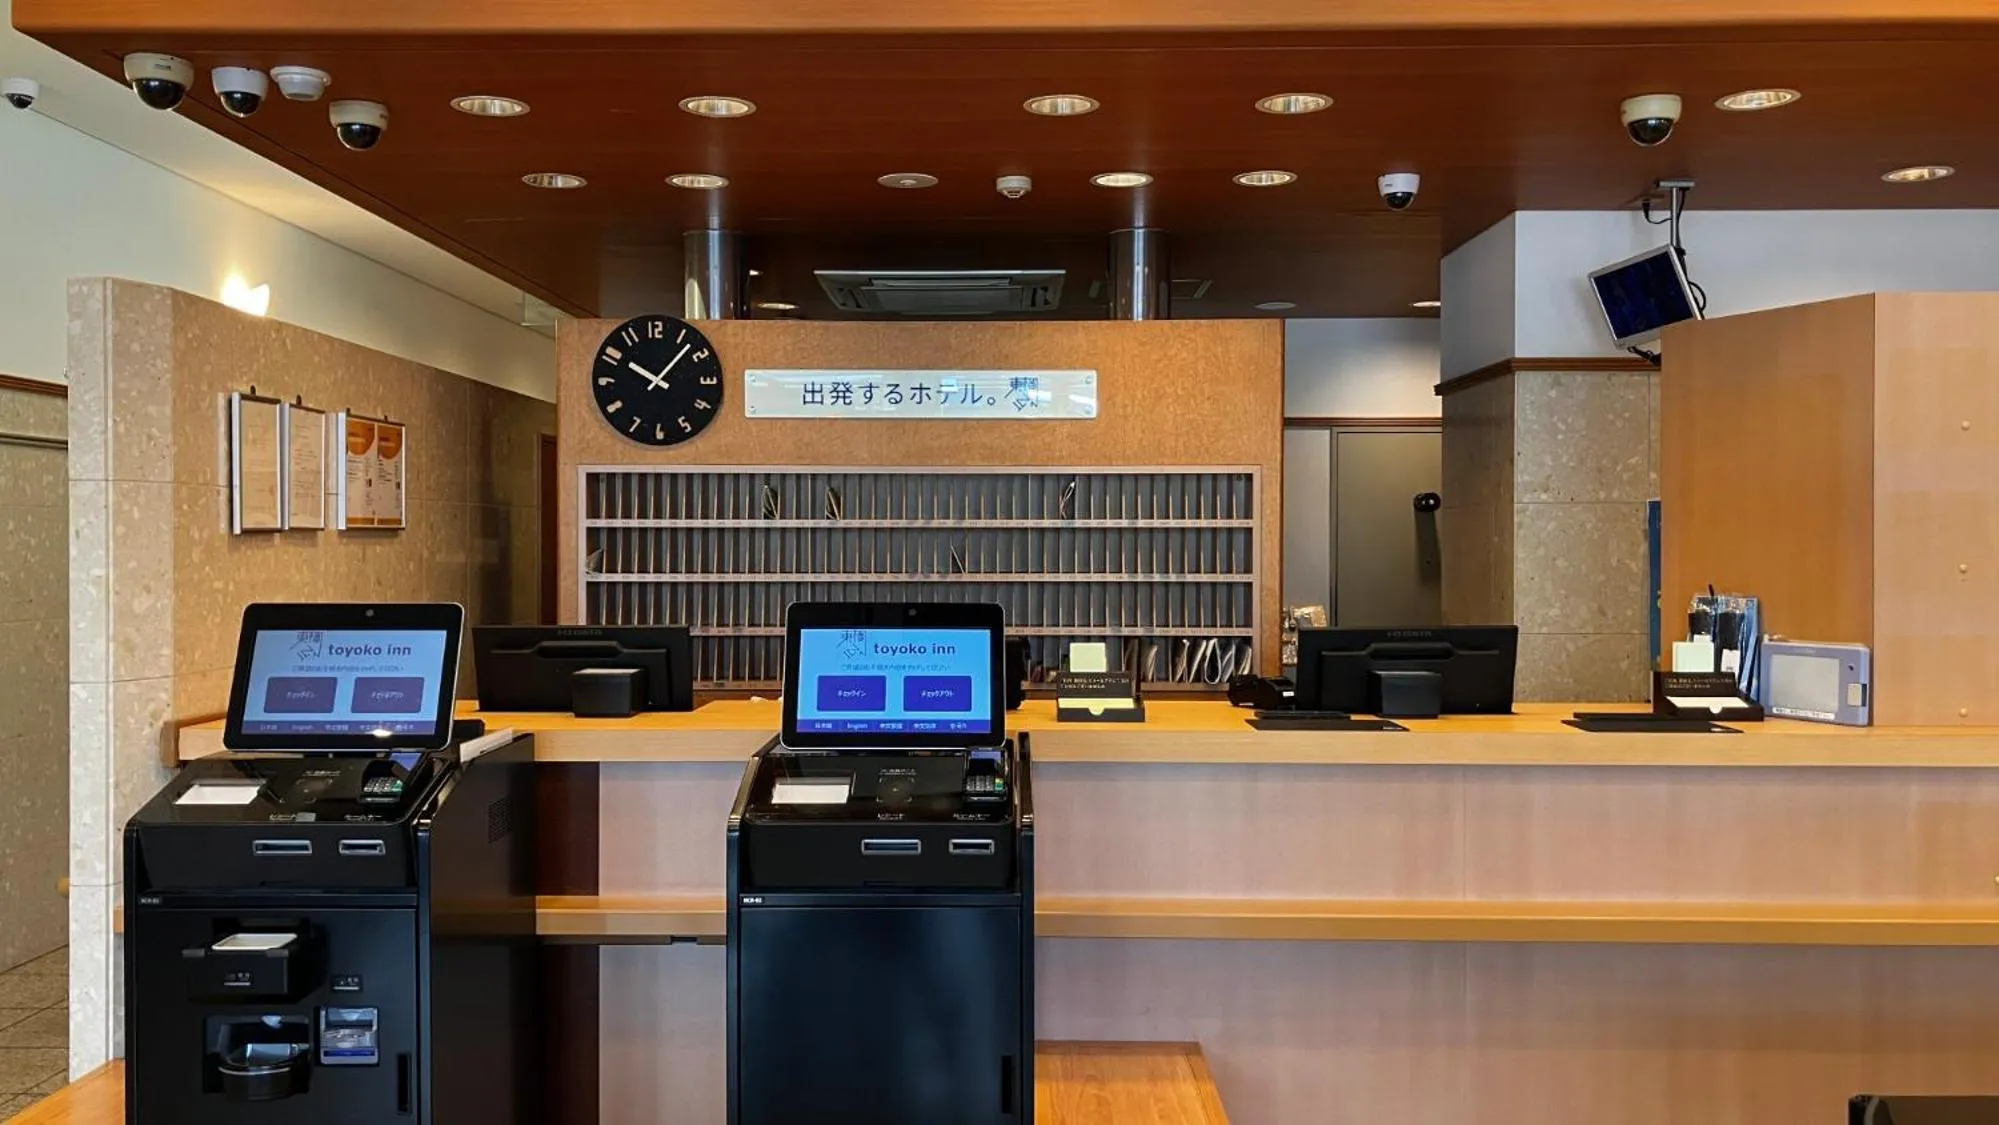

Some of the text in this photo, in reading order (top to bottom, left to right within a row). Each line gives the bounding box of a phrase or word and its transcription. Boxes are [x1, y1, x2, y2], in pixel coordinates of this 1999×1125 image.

[621, 327, 639, 347] 11
[648, 321, 663, 338] 12
[676, 328, 686, 344] 1
[692, 347, 710, 362] 2
[598, 377, 615, 386] 9
[700, 376, 717, 385] 3
[802, 381, 997, 406] 出発するホテル。
[694, 399, 711, 410] 4
[629, 416, 641, 433] 7
[655, 423, 664, 440] 6
[677, 416, 692, 433] 5
[328, 643, 382, 657] toyoko
[387, 643, 412, 656] inn
[874, 643, 927, 657] toyoko
[932, 643, 956, 655] inn
